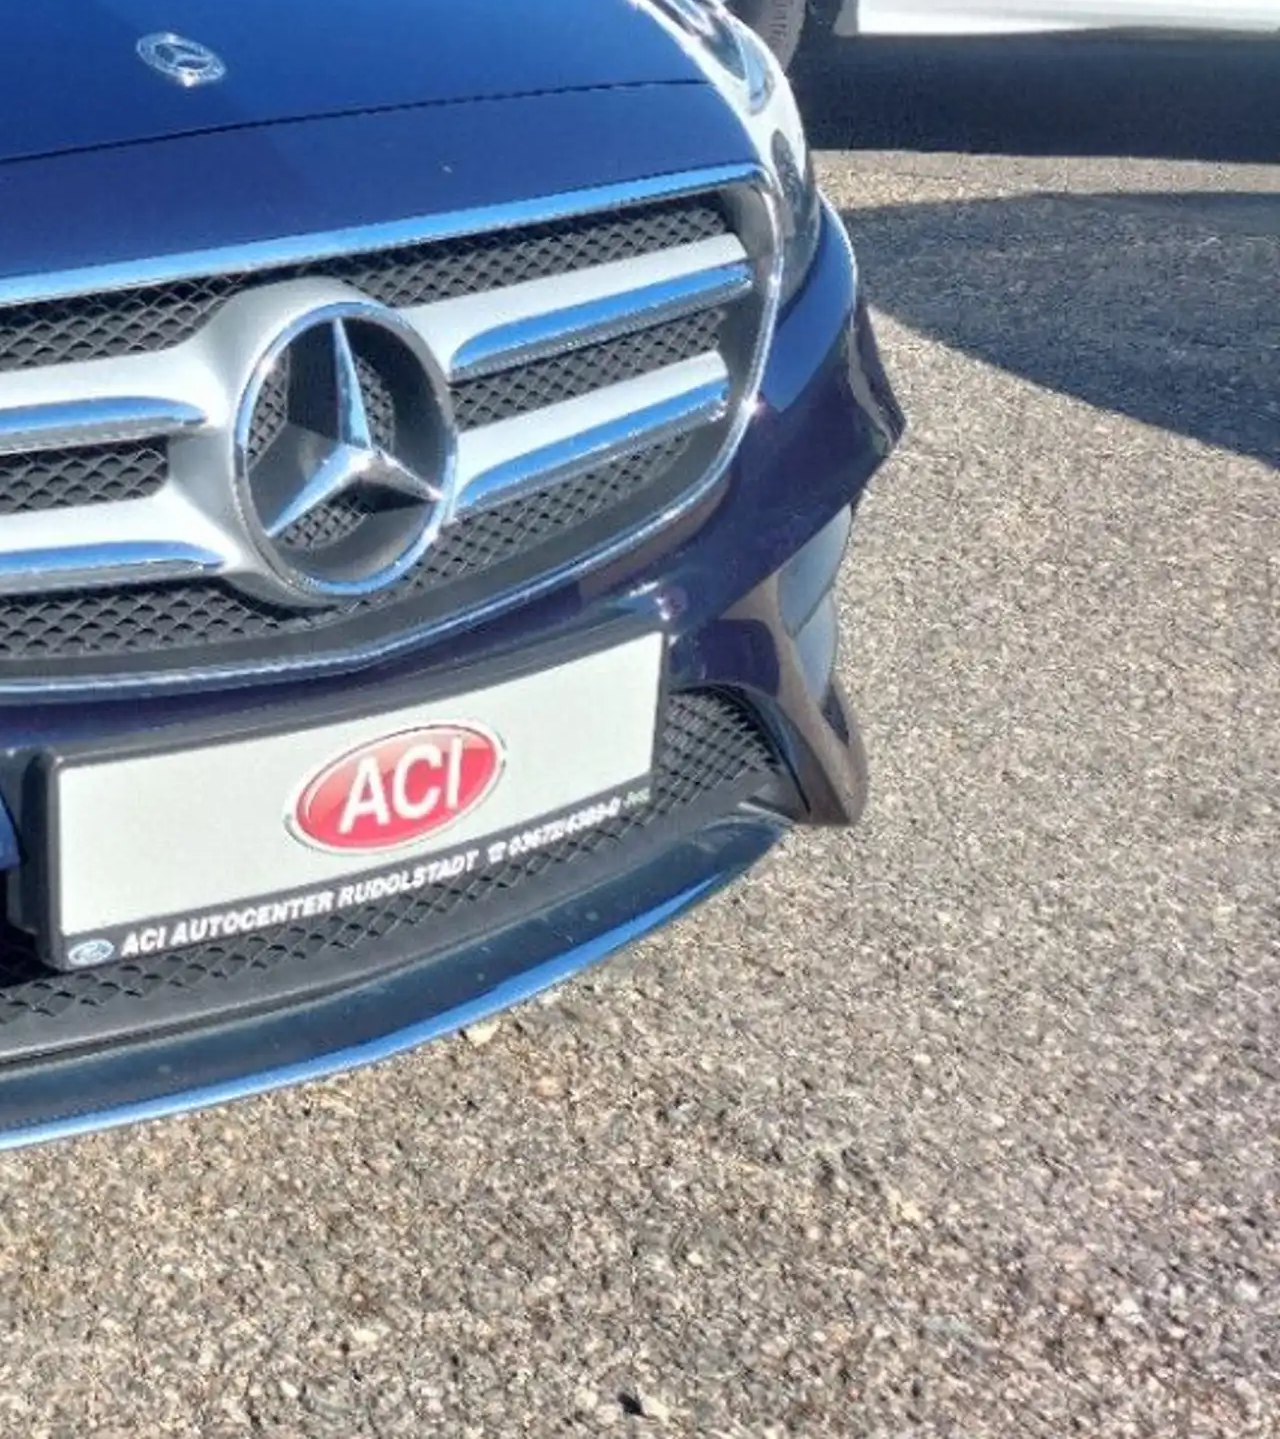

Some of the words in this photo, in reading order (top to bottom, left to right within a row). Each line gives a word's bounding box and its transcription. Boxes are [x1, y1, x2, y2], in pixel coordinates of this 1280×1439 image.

[337, 736, 465, 836] ACI
[120, 925, 168, 959] ACI
[169, 889, 334, 946] AUTOCENTER
[337, 849, 480, 908] RUDOLSTADT
